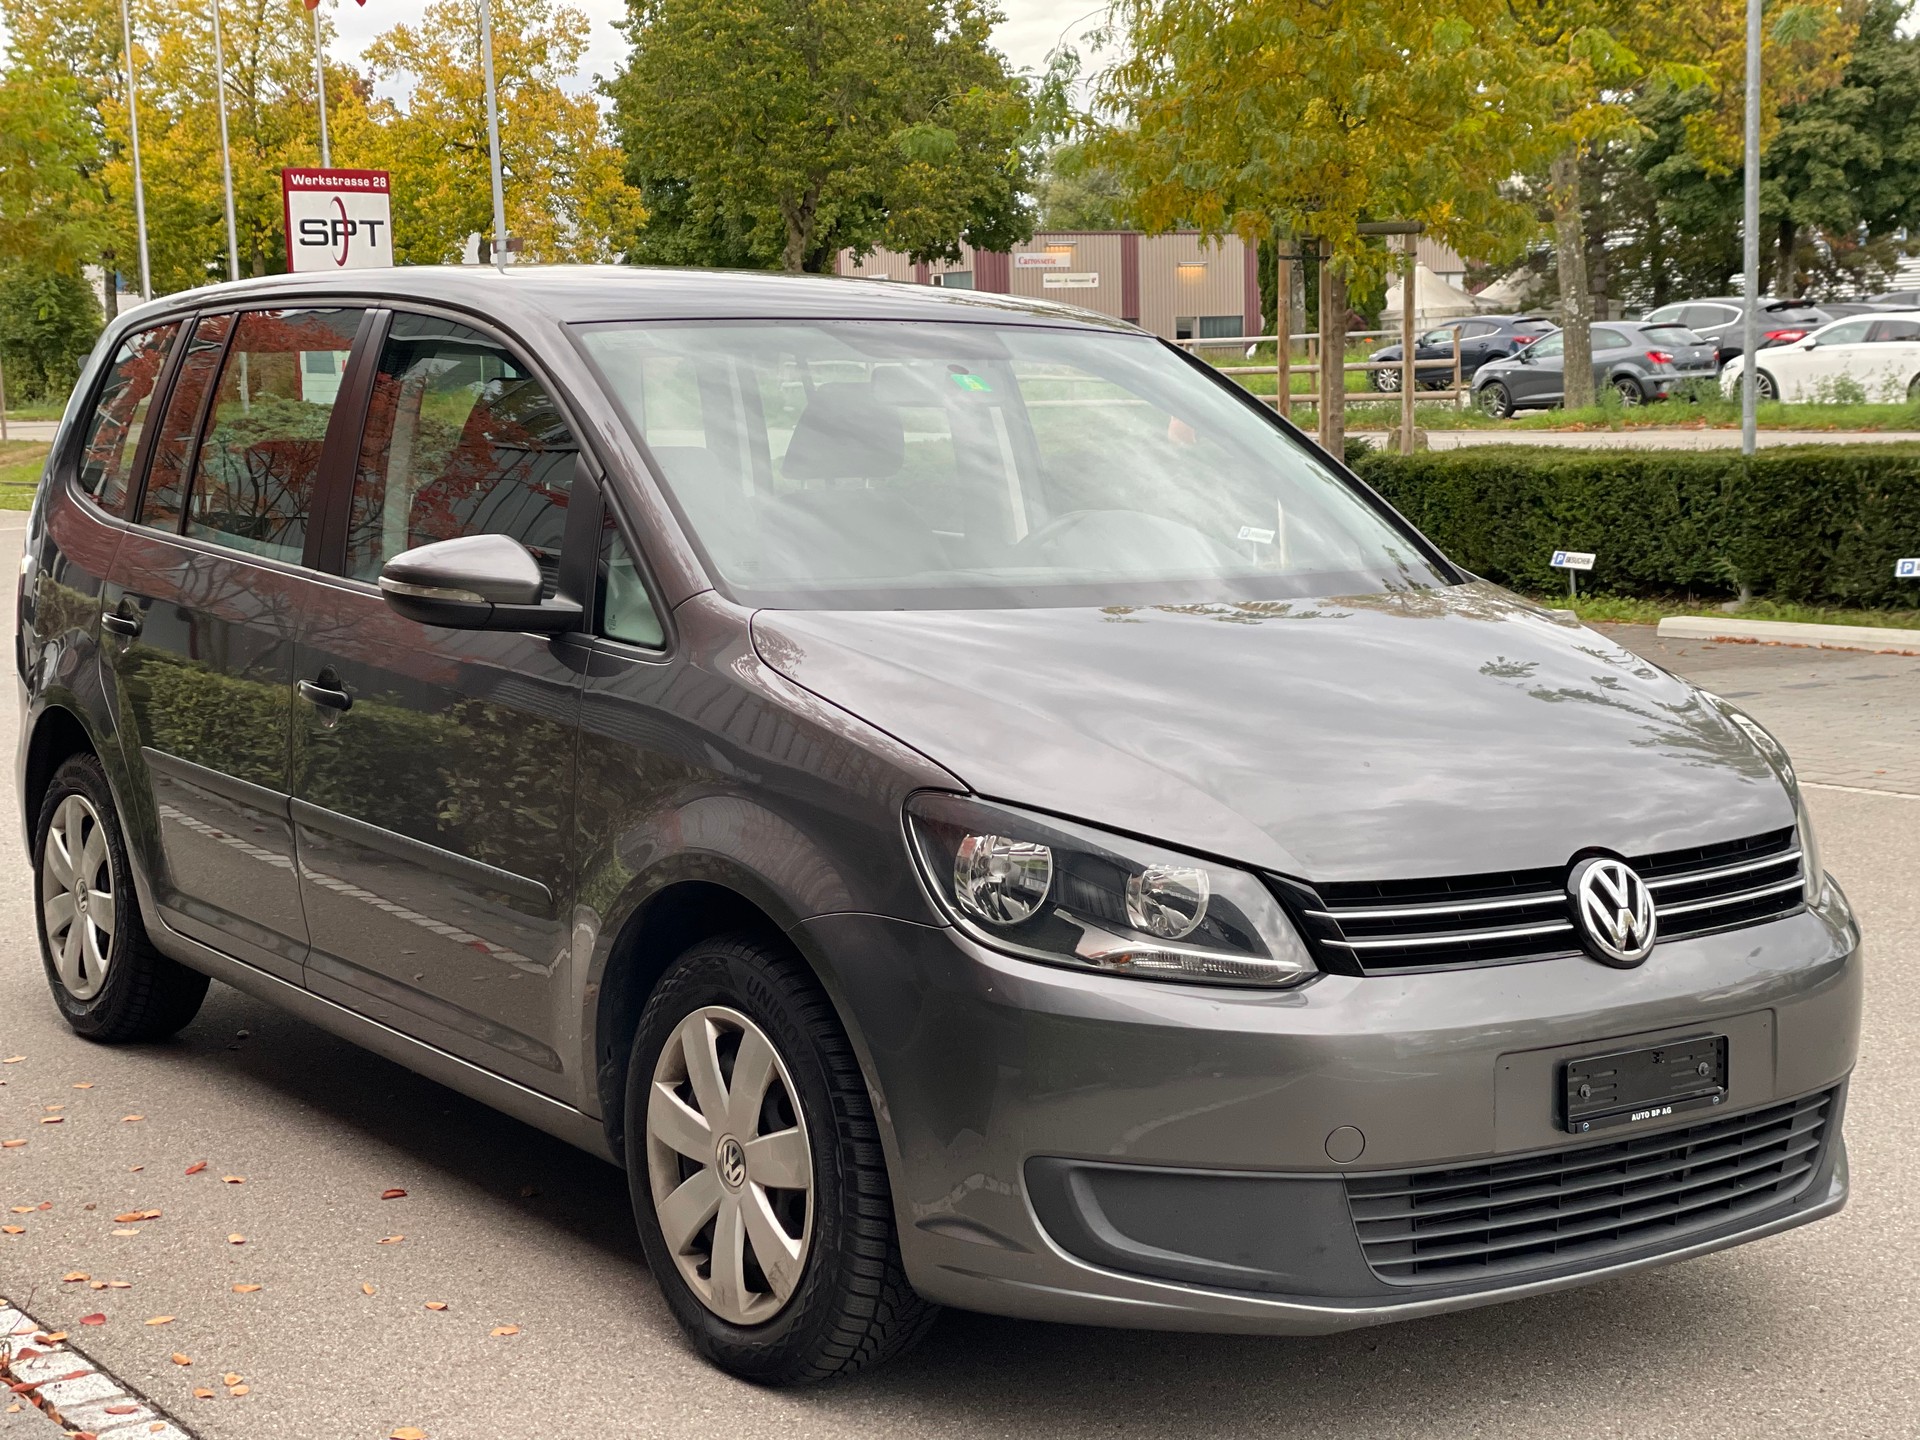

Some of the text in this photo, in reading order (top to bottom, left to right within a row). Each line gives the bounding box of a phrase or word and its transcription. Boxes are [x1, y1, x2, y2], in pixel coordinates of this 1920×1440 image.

[290, 174, 387, 188] Werkstrasse 28
[299, 218, 385, 248] SPT
[1018, 256, 1057, 265] Carrosserie
[1631, 1111, 1650, 1121] AUTO
[1662, 1106, 1672, 1115] AG
